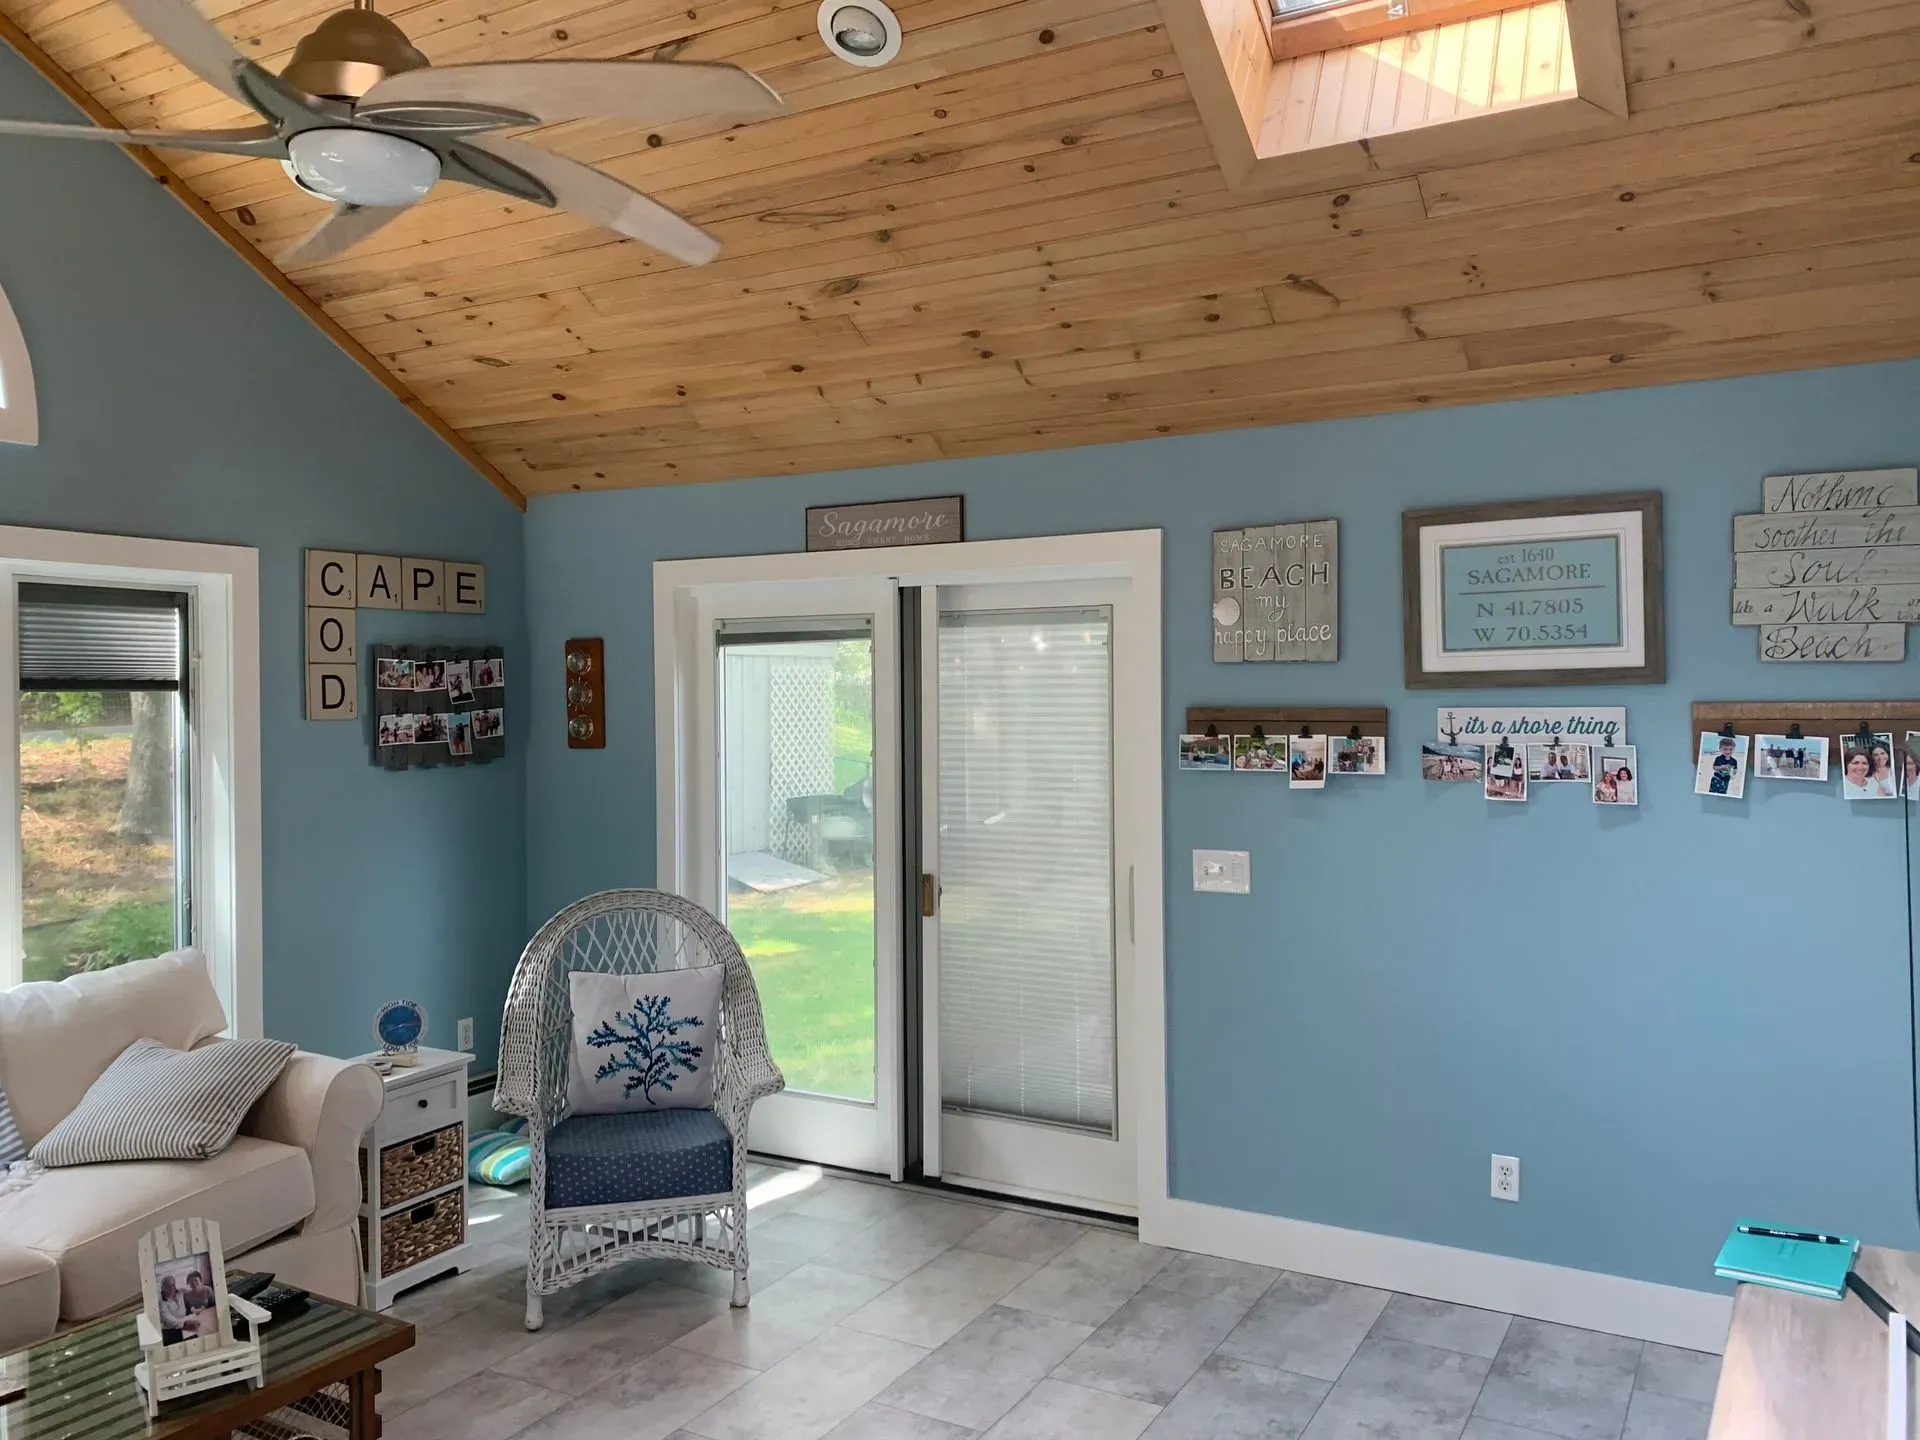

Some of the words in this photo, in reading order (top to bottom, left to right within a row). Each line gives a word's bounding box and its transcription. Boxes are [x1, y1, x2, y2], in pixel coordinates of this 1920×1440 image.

[818, 511, 948, 541] Sagamore
[1755, 516, 1838, 549] soothes
[1865, 513, 1906, 545] the
[1220, 533, 1326, 552] SAGAMORE
[1497, 554, 1515, 564] est
[1522, 547, 1555, 563] 1640
[1219, 562, 1330, 590] BEACH
[1467, 563, 1592, 586] SAGAMORE
[1768, 549, 1877, 587] Soul
[320, 561, 477, 605] CAPE
[1255, 595, 1290, 622] my
[1475, 603, 1494, 618] N
[1504, 598, 1584, 616] 41.7805
[1764, 604, 1773, 614] a
[1783, 586, 1884, 622] Walk
[1214, 626, 1266, 656] happy
[1277, 623, 1332, 653] place
[1472, 627, 1496, 643] W
[1505, 624, 1588, 642] 70.5354
[1765, 624, 1873, 660] Beach
[1465, 716, 1488, 734] its
[1491, 720, 1506, 734] a
[1508, 716, 1564, 734] shore
[1566, 716, 1620, 735] thing
[402, 999, 418, 1008] TIDE
[383, 1043, 401, 1052] LOW
